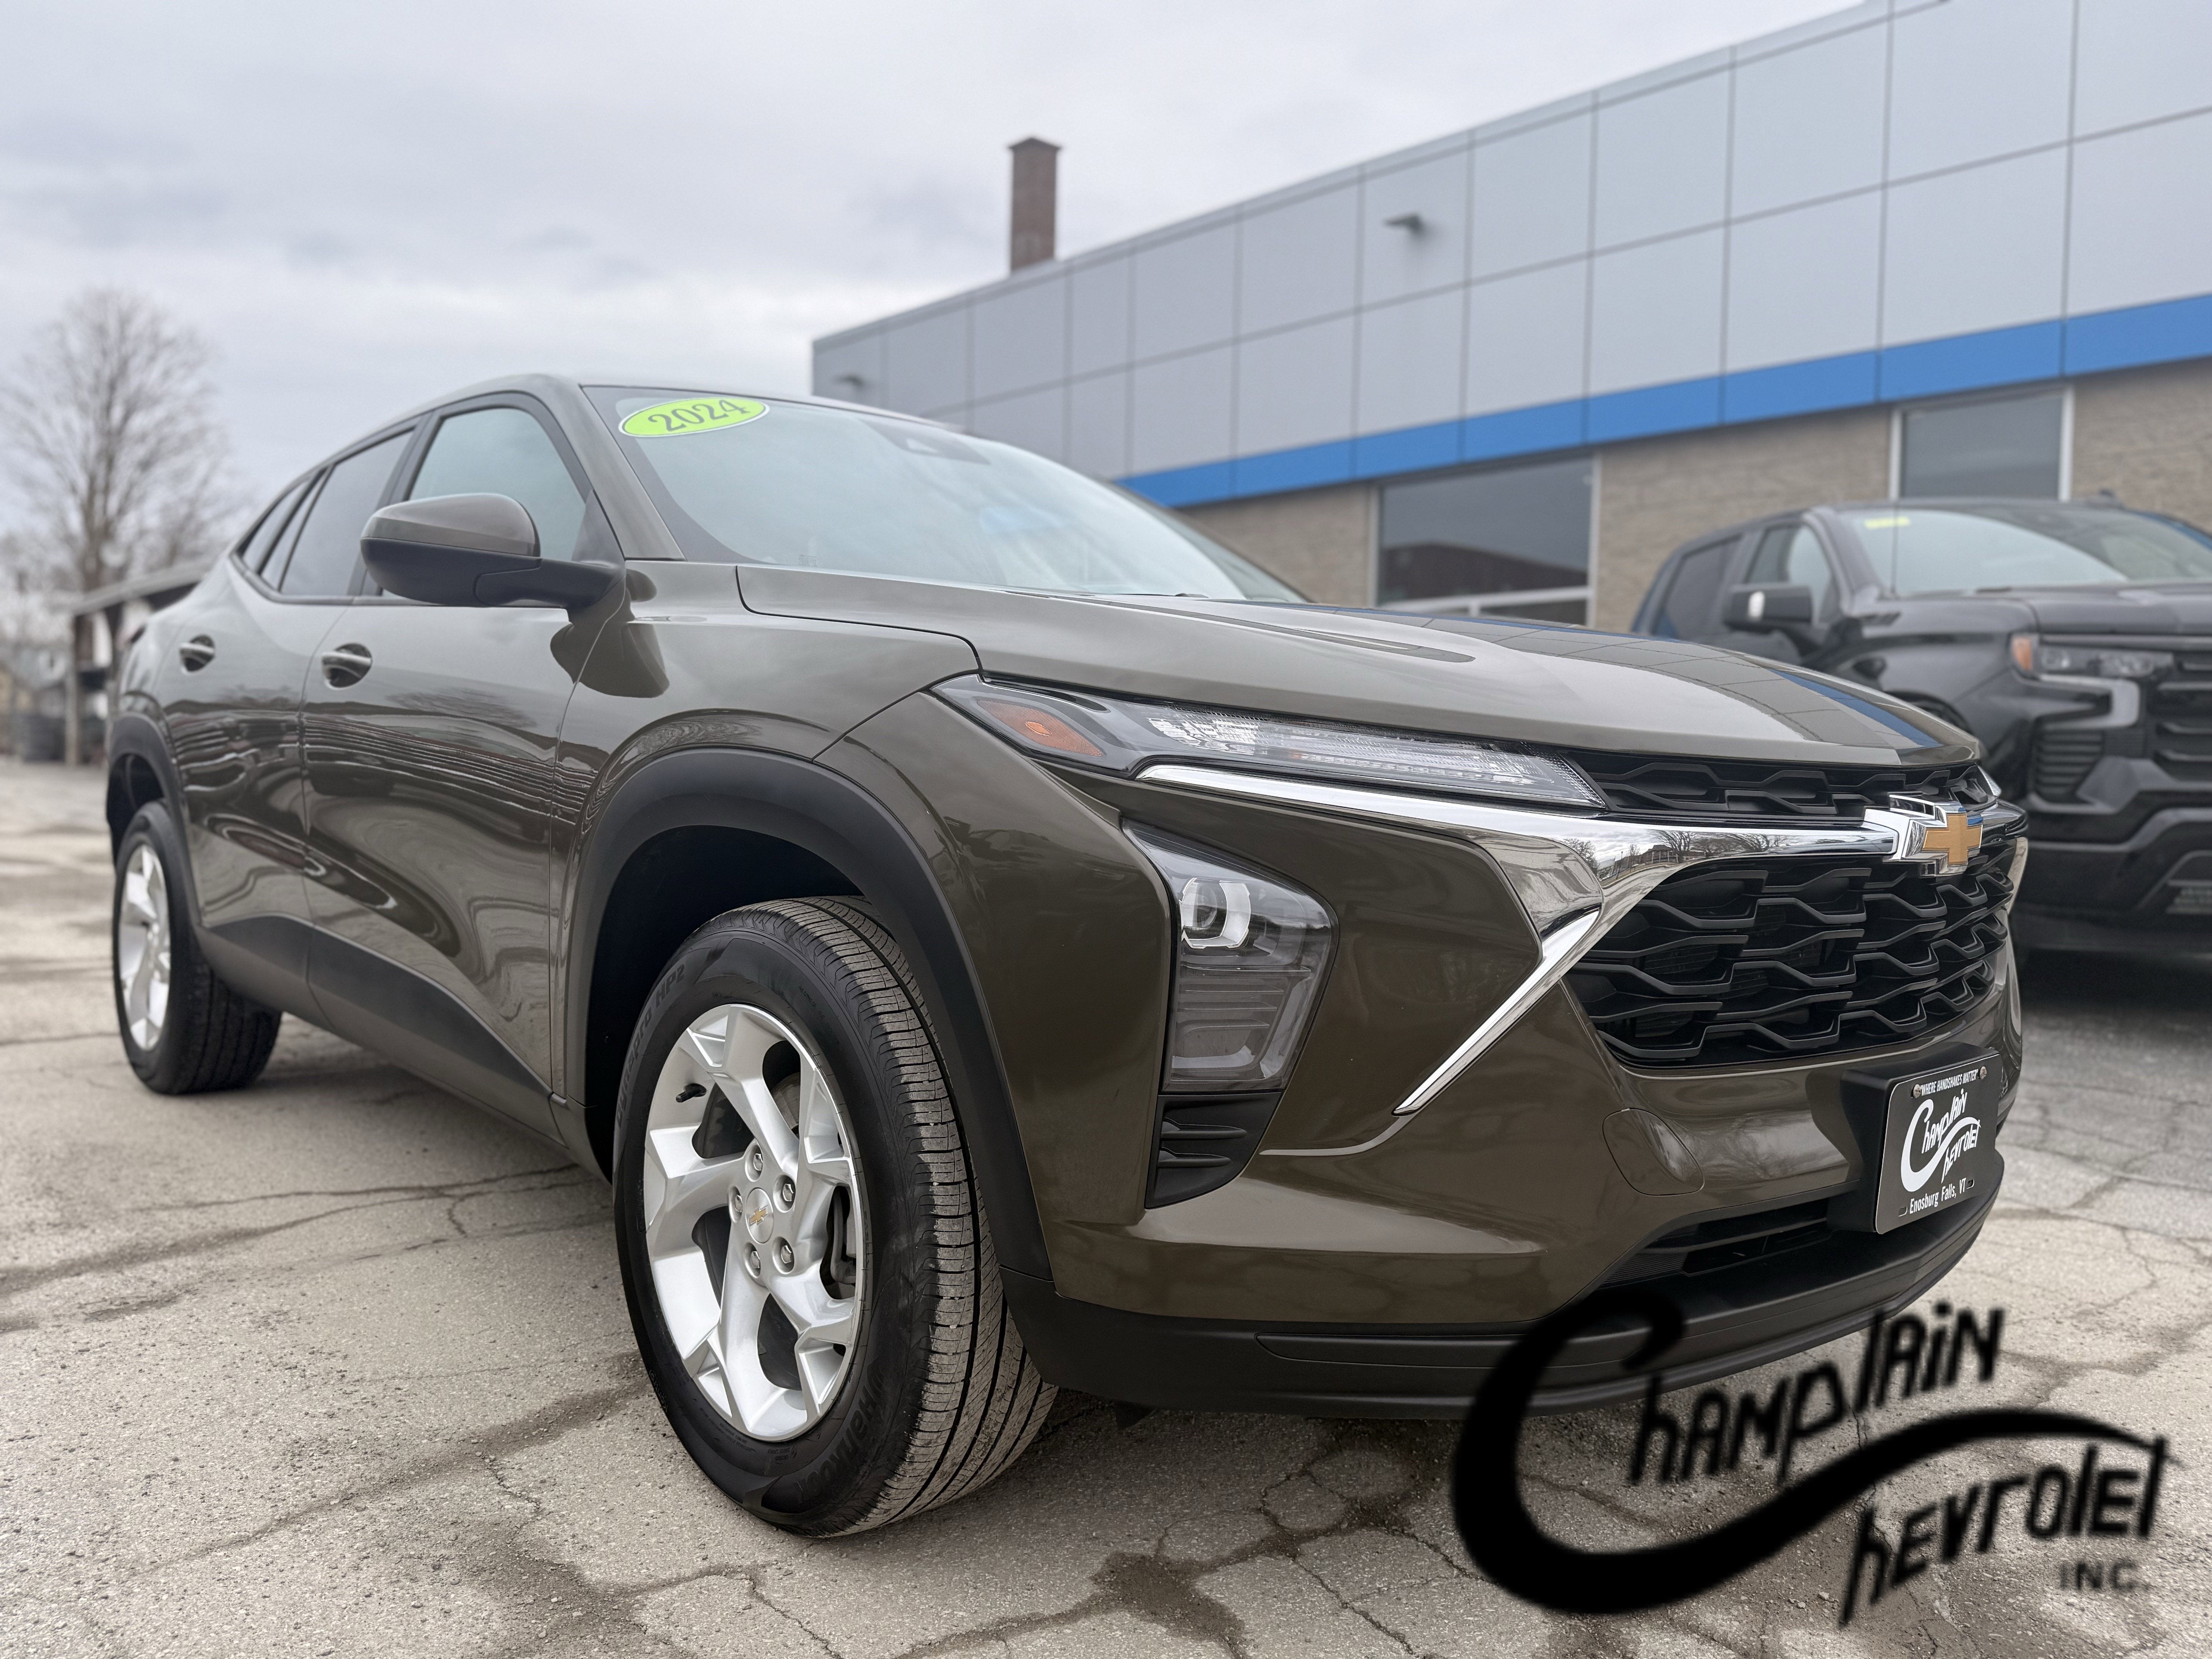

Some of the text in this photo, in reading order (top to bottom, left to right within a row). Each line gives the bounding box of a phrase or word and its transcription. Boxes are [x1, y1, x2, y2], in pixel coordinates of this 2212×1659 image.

[647, 399, 750, 432] 2024
[656, 963, 685, 1008] HP2
[1936, 1073, 1963, 1092] HANDSHAKES
[1909, 1177, 1966, 1214] Enosburg Falls, VT
